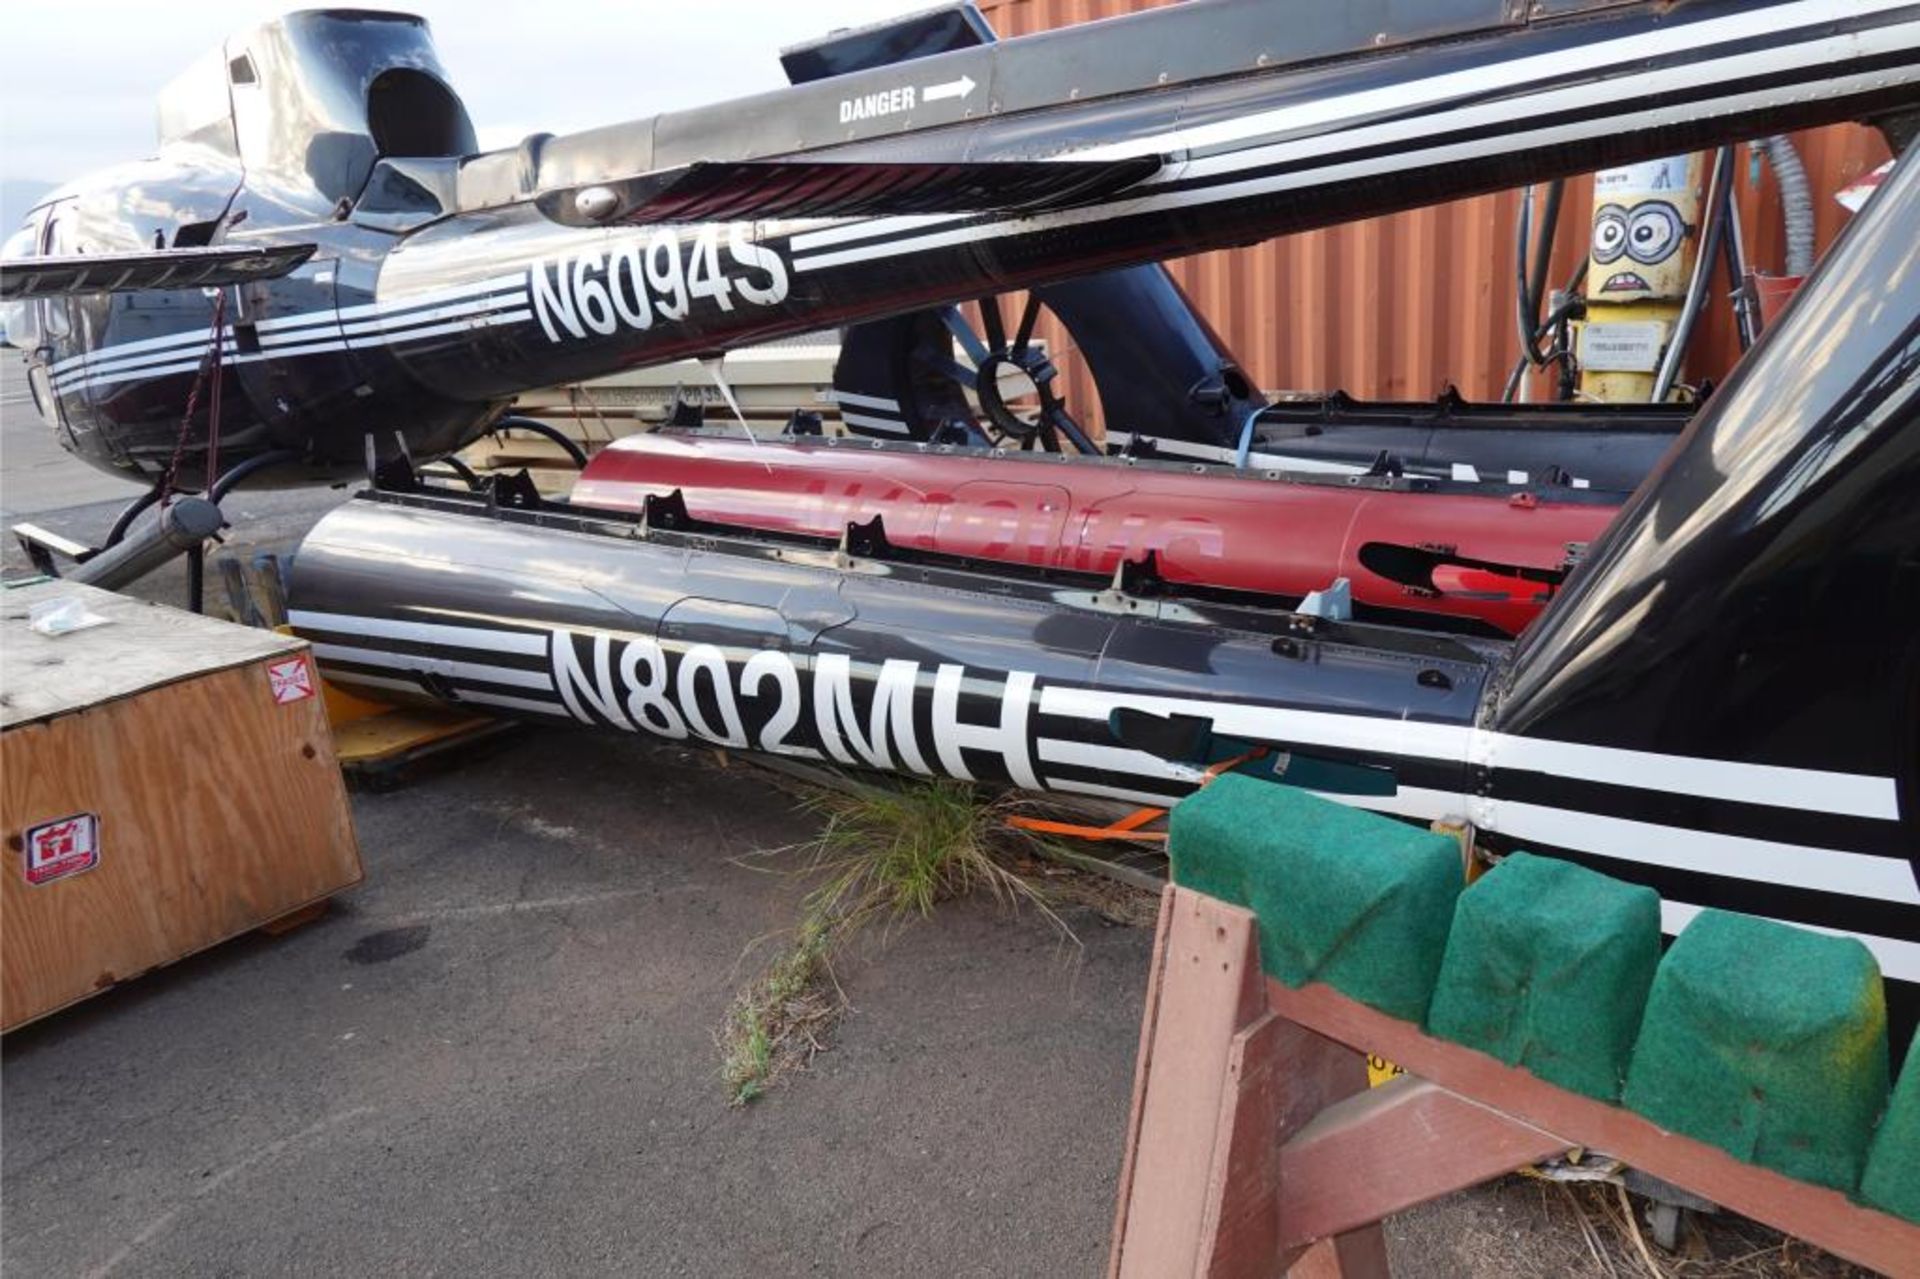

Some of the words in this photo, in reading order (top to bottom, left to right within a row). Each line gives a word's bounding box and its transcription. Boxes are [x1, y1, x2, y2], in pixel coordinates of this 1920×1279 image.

[839, 85, 916, 124] DANGER
[530, 222, 789, 343] N6094S
[551, 628, 1042, 793] N802MH
